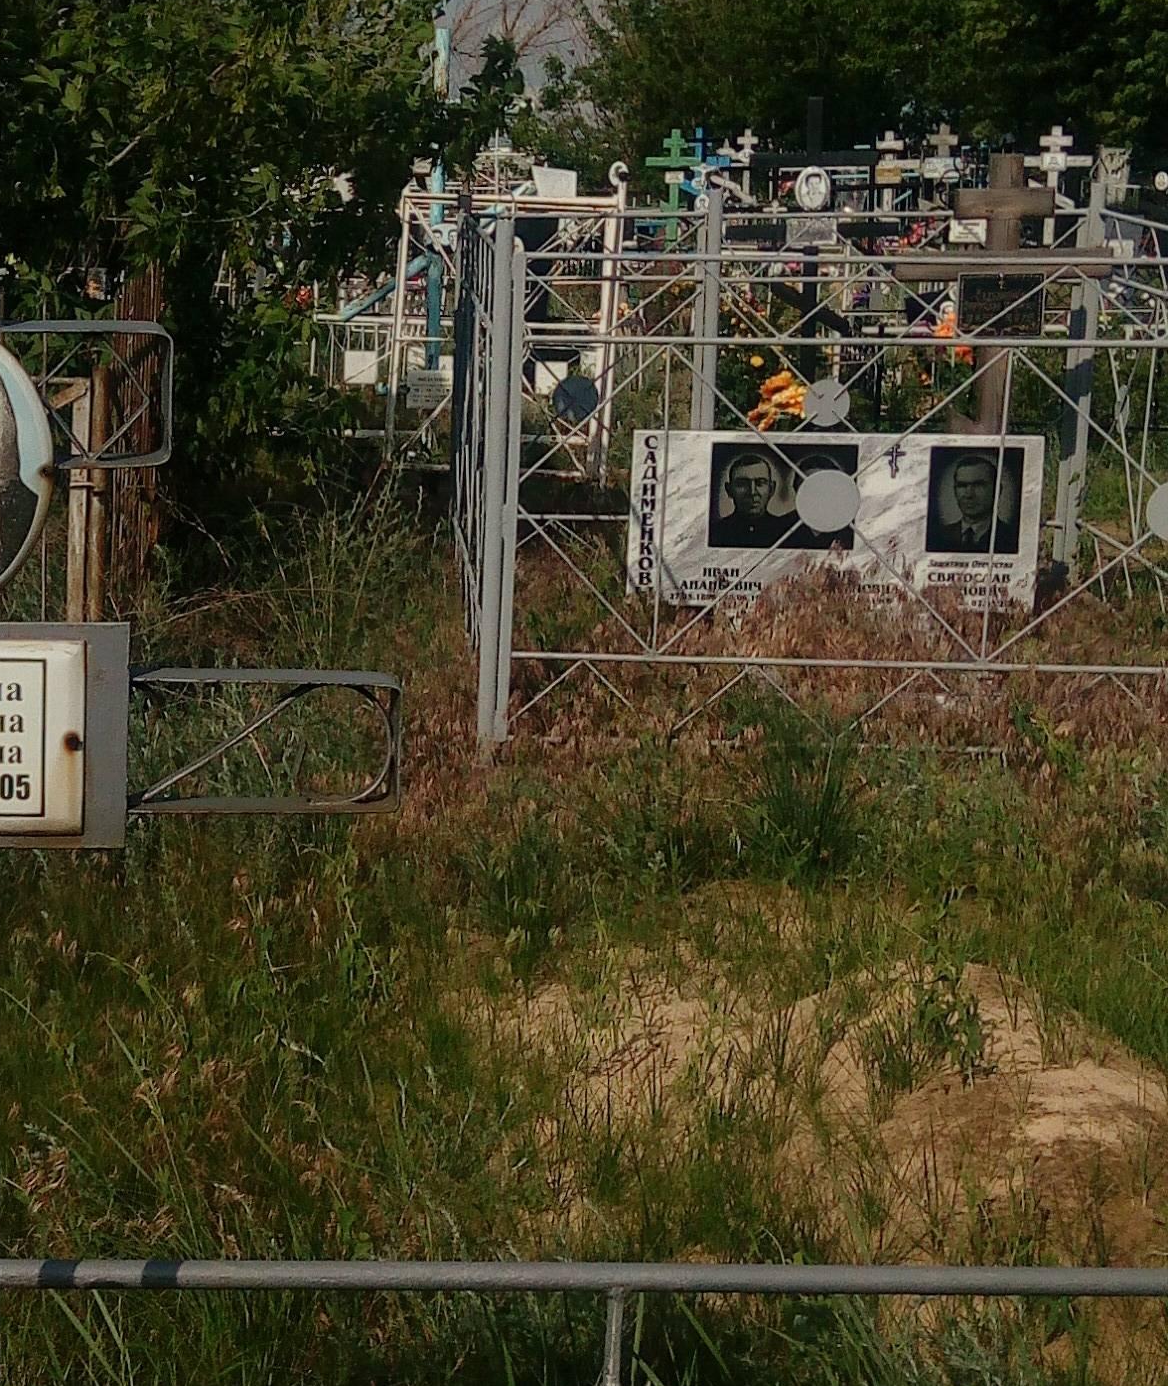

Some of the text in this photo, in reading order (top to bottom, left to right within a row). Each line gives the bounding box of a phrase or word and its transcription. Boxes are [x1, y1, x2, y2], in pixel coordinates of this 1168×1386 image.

[703, 566, 740, 578] ИВАН
[680, 580, 762, 591] АНАНЬВИЧ
[0, 774, 30, 800] 05
